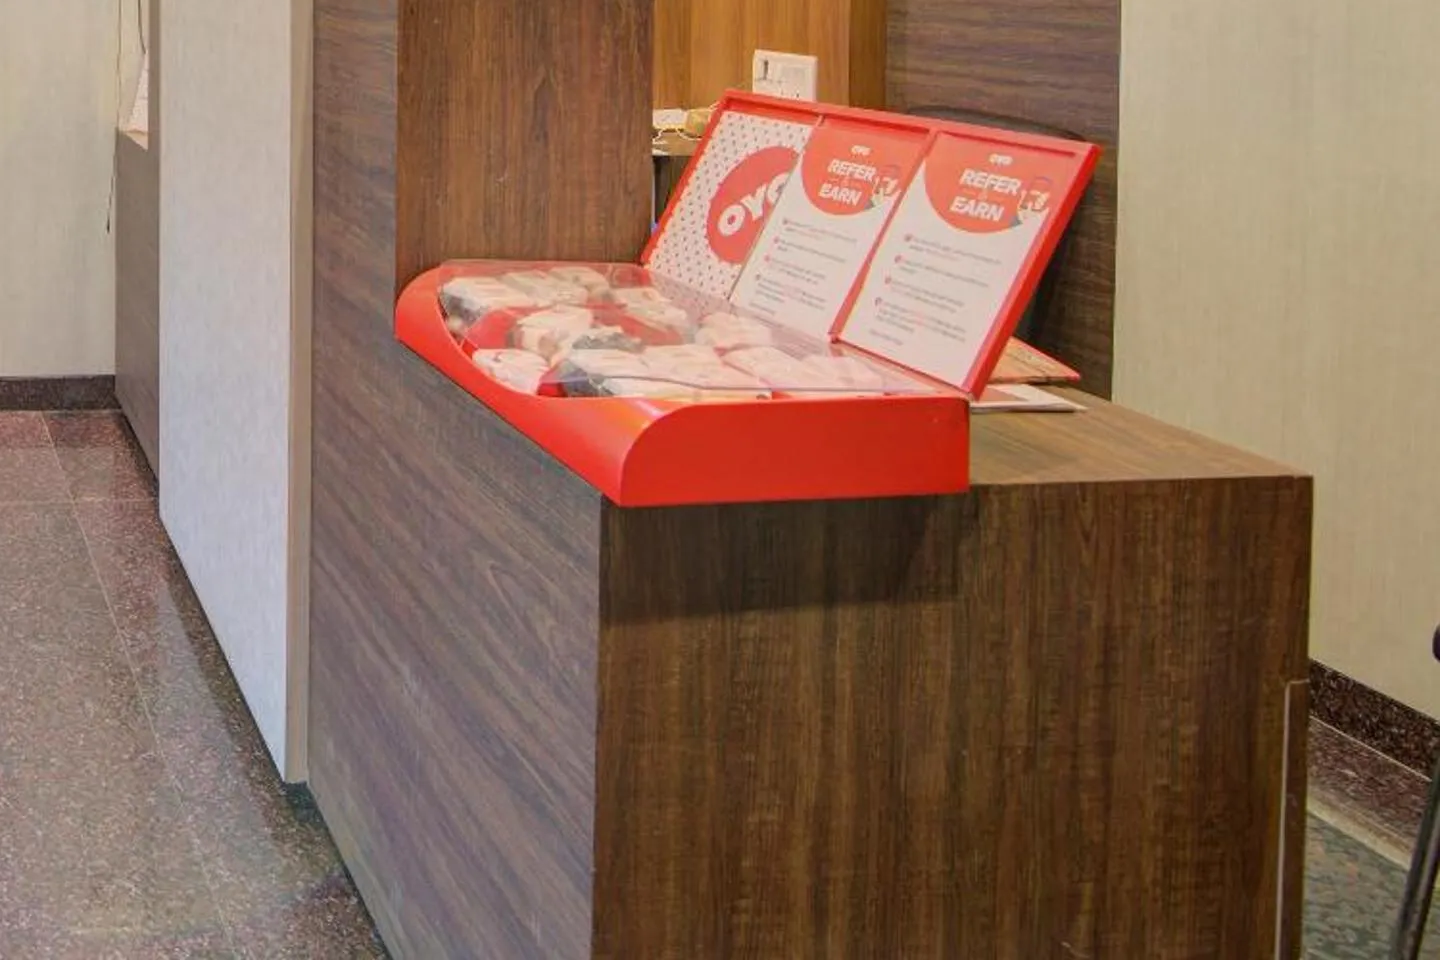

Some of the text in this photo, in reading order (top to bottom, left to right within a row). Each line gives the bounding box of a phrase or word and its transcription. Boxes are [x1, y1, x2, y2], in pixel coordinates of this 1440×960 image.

[827, 159, 877, 182] REFER
[959, 168, 1022, 196] REFER
[818, 182, 862, 207] EARN
[949, 195, 1005, 222] EARN
